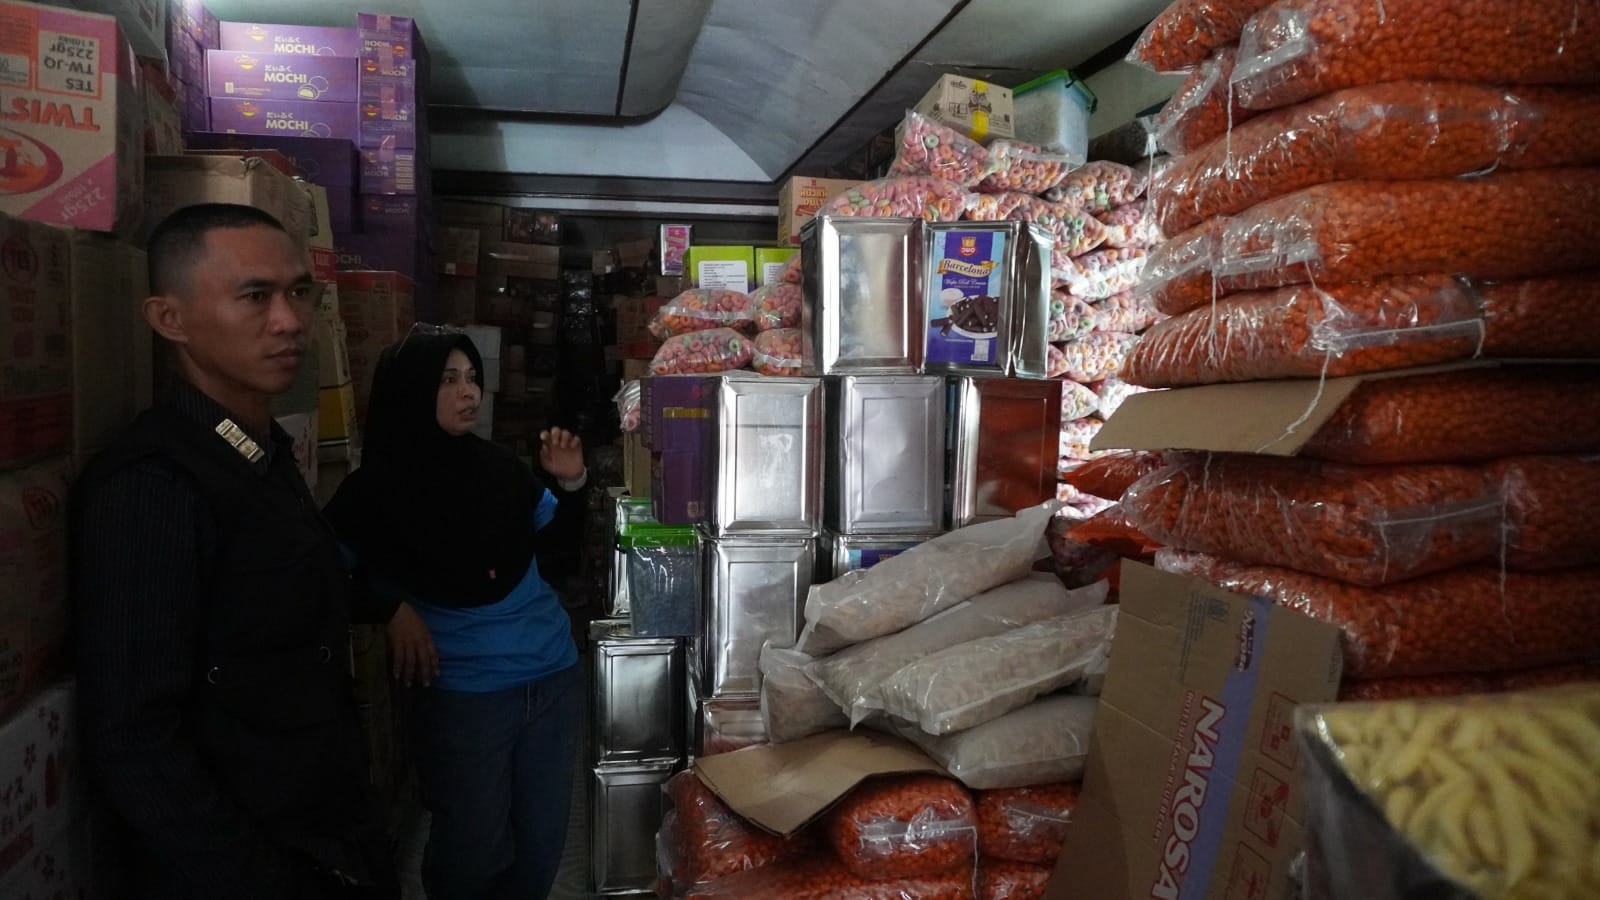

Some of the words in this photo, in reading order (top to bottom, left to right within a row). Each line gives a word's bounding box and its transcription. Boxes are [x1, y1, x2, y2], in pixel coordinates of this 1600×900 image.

[49, 45, 95, 59] 225gr
[273, 44, 315, 54] MOCHI
[44, 58, 95, 76] TW-JQ
[66, 78, 95, 93] TES
[263, 73, 308, 84] MOCHI
[265, 120, 309, 131] MOCHI
[60, 187, 107, 222] 225gr
[943, 259, 989, 275] Barcelona
[1151, 696, 1226, 900] NAROSA
